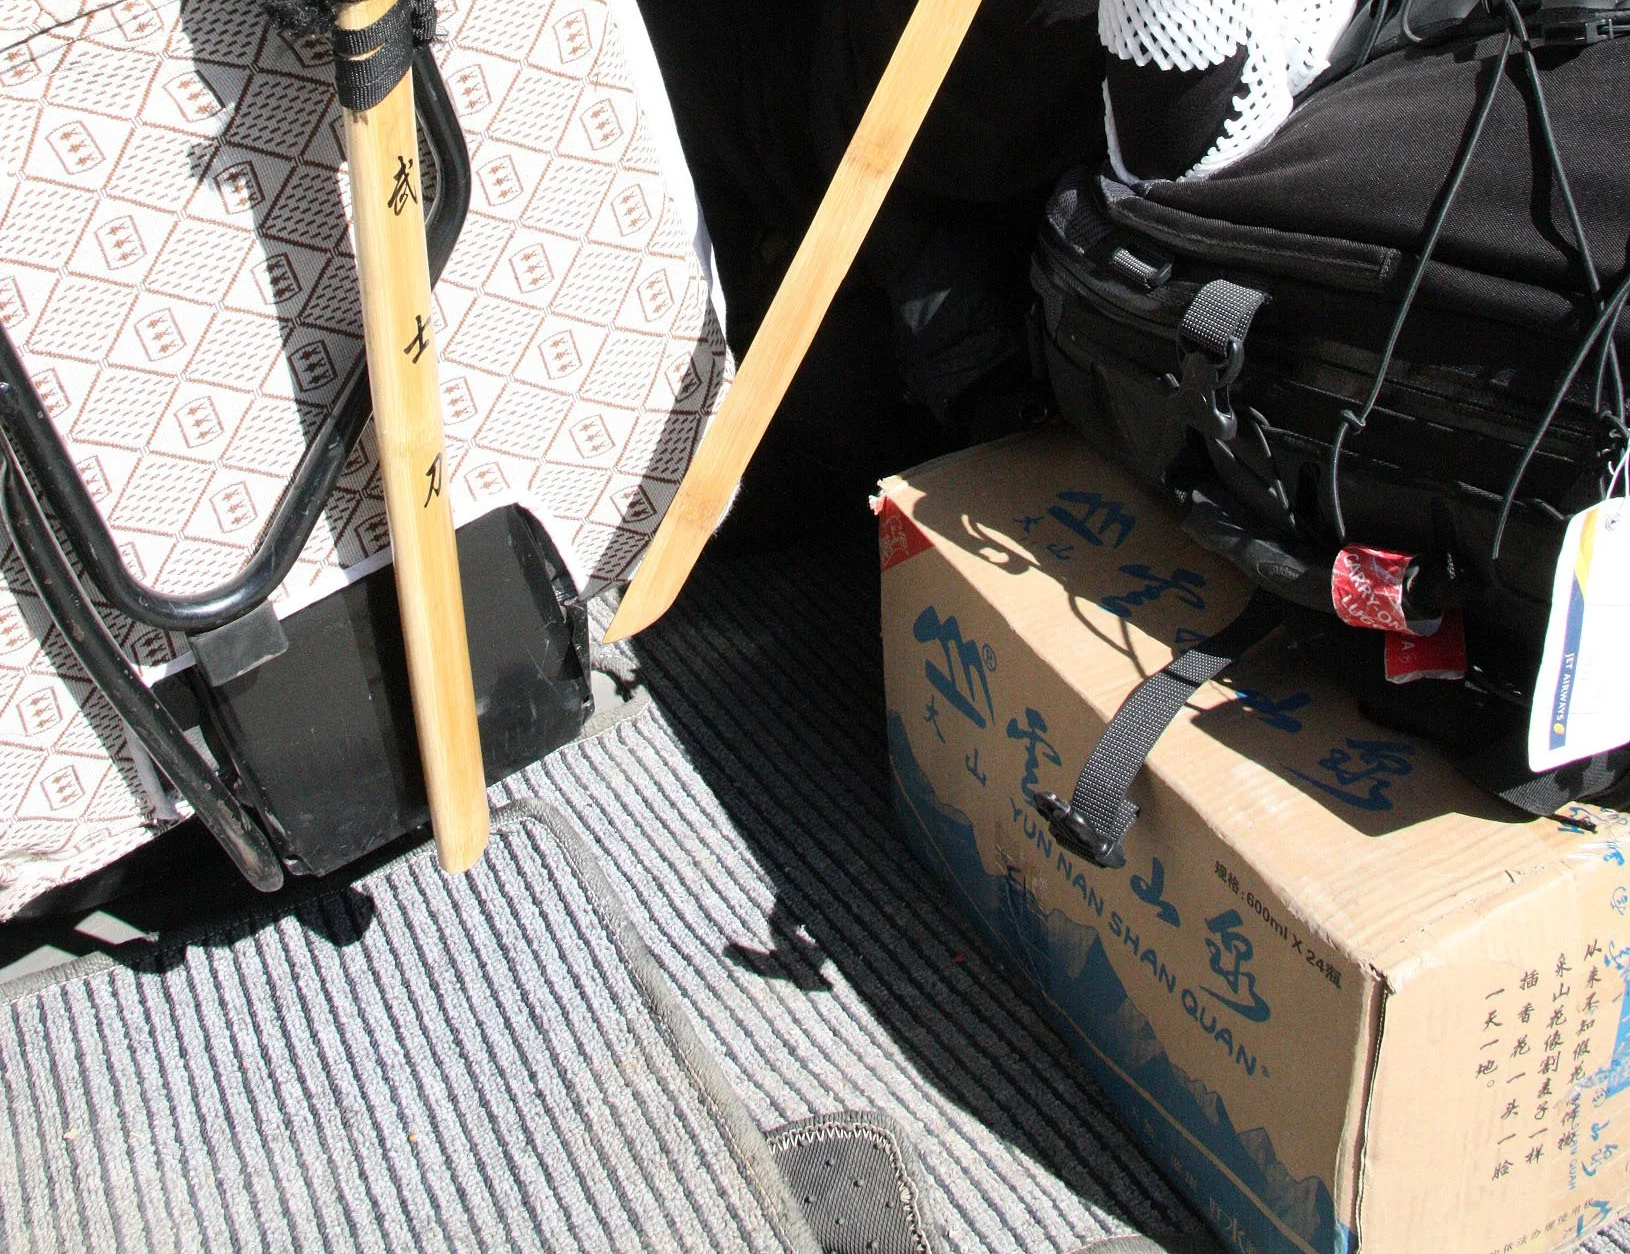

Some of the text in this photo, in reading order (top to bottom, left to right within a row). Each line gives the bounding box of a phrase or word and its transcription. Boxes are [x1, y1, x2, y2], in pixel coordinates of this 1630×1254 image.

[1556, 652, 1575, 721] JET AIRWAYS
[1010, 797, 1053, 858] YUN
[1056, 851, 1104, 918] NAN
[1108, 910, 1178, 994] SHAN
[1181, 988, 1258, 1077] QUAN
